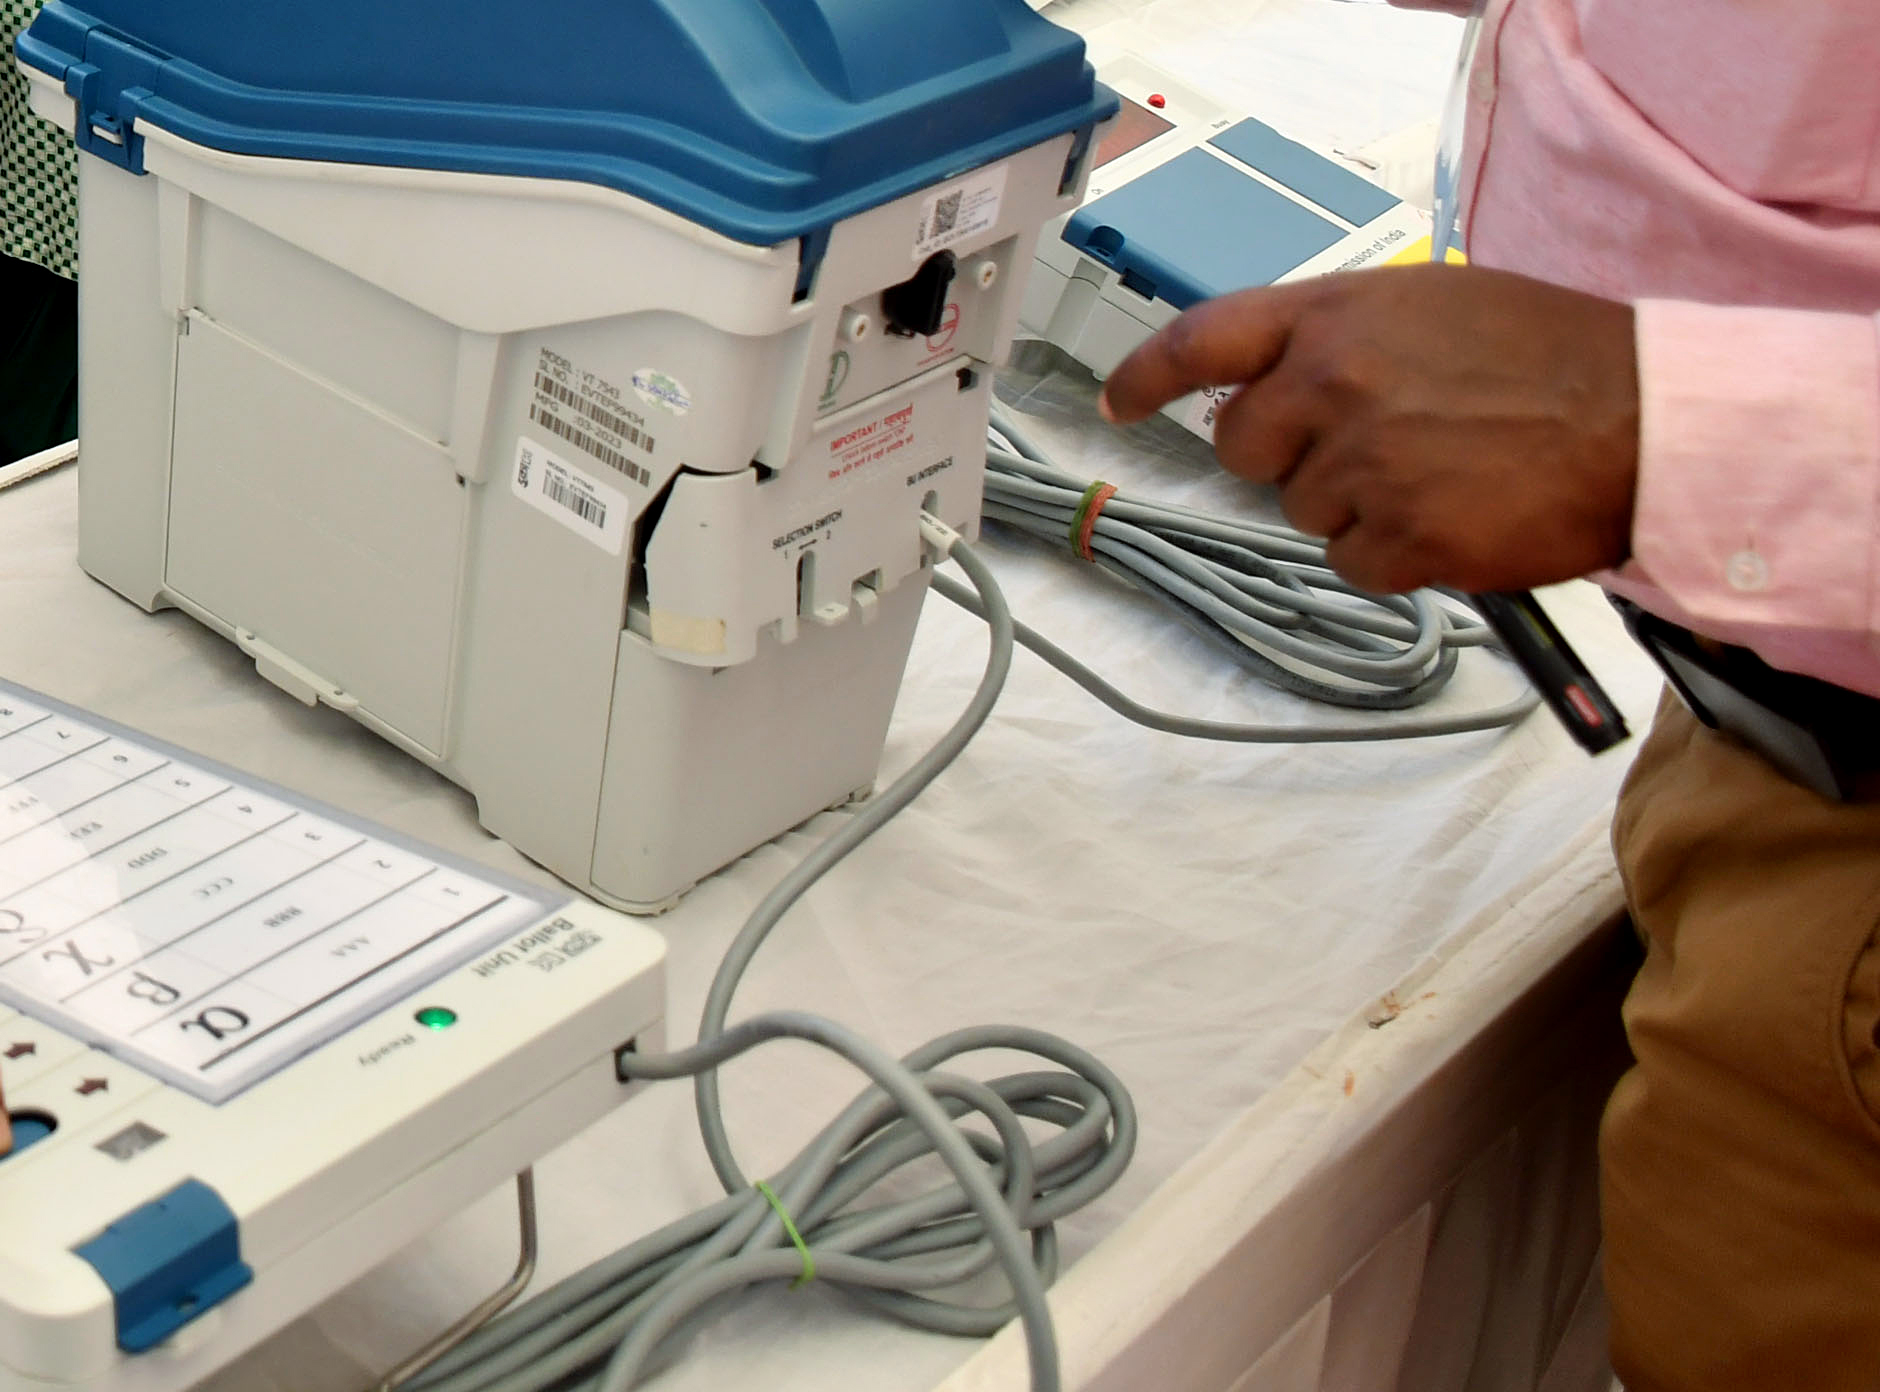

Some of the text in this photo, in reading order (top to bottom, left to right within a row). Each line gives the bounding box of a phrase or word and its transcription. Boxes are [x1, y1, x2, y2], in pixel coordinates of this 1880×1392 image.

[1373, 240, 1386, 251] of
[1379, 229, 1406, 245] India
[541, 347, 572, 374] MODEL
[582, 371, 595, 385] VT
[536, 392, 559, 413] MFG
[830, 421, 877, 451] IMPORTANT
[918, 456, 953, 481] INTERFACE
[772, 509, 842, 550] SELECTION SWITCH
[57, 730, 71, 740] 7
[113, 754, 128, 763] 6
[174, 778, 190, 788] 5
[238, 804, 253, 814] 4
[303, 831, 321, 842] 3
[127, 847, 168, 869] DDD
[372, 856, 393, 870] 2
[193, 877, 234, 898] CCC
[264, 906, 303, 928] BBB
[519, 916, 575, 953] Ballot
[180, 886, 460, 1040] 1 AAA α
[472, 951, 520, 978] Unit
[359, 1033, 417, 1067] Ready
